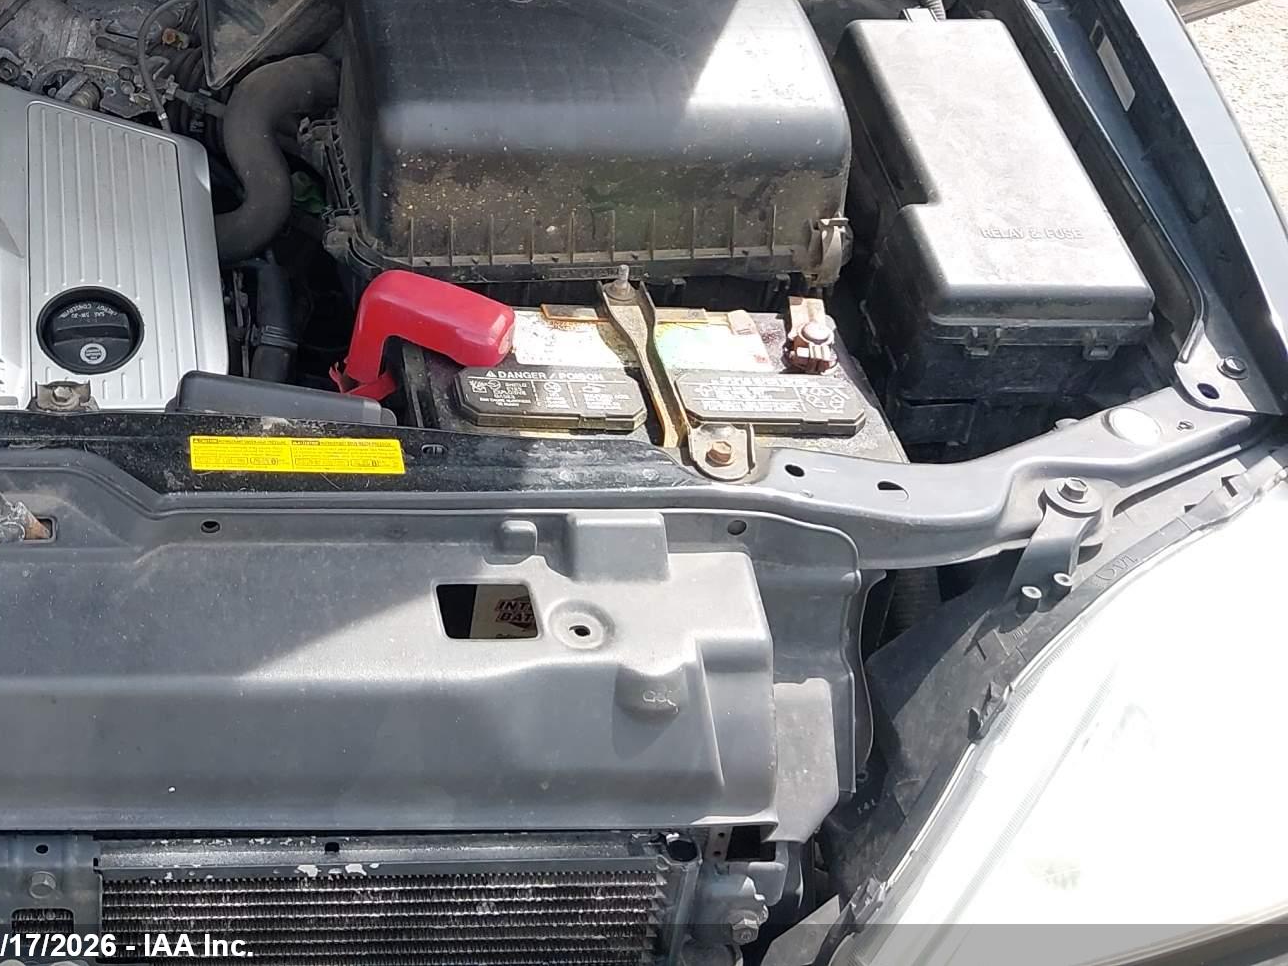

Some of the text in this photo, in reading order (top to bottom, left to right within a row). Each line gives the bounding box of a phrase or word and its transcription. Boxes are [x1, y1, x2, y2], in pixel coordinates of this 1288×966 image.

[978, 226, 1024, 240] RELAY
[1044, 227, 1084, 241] FUSE
[498, 371, 547, 380] DANGER
[558, 372, 604, 381] POISON
